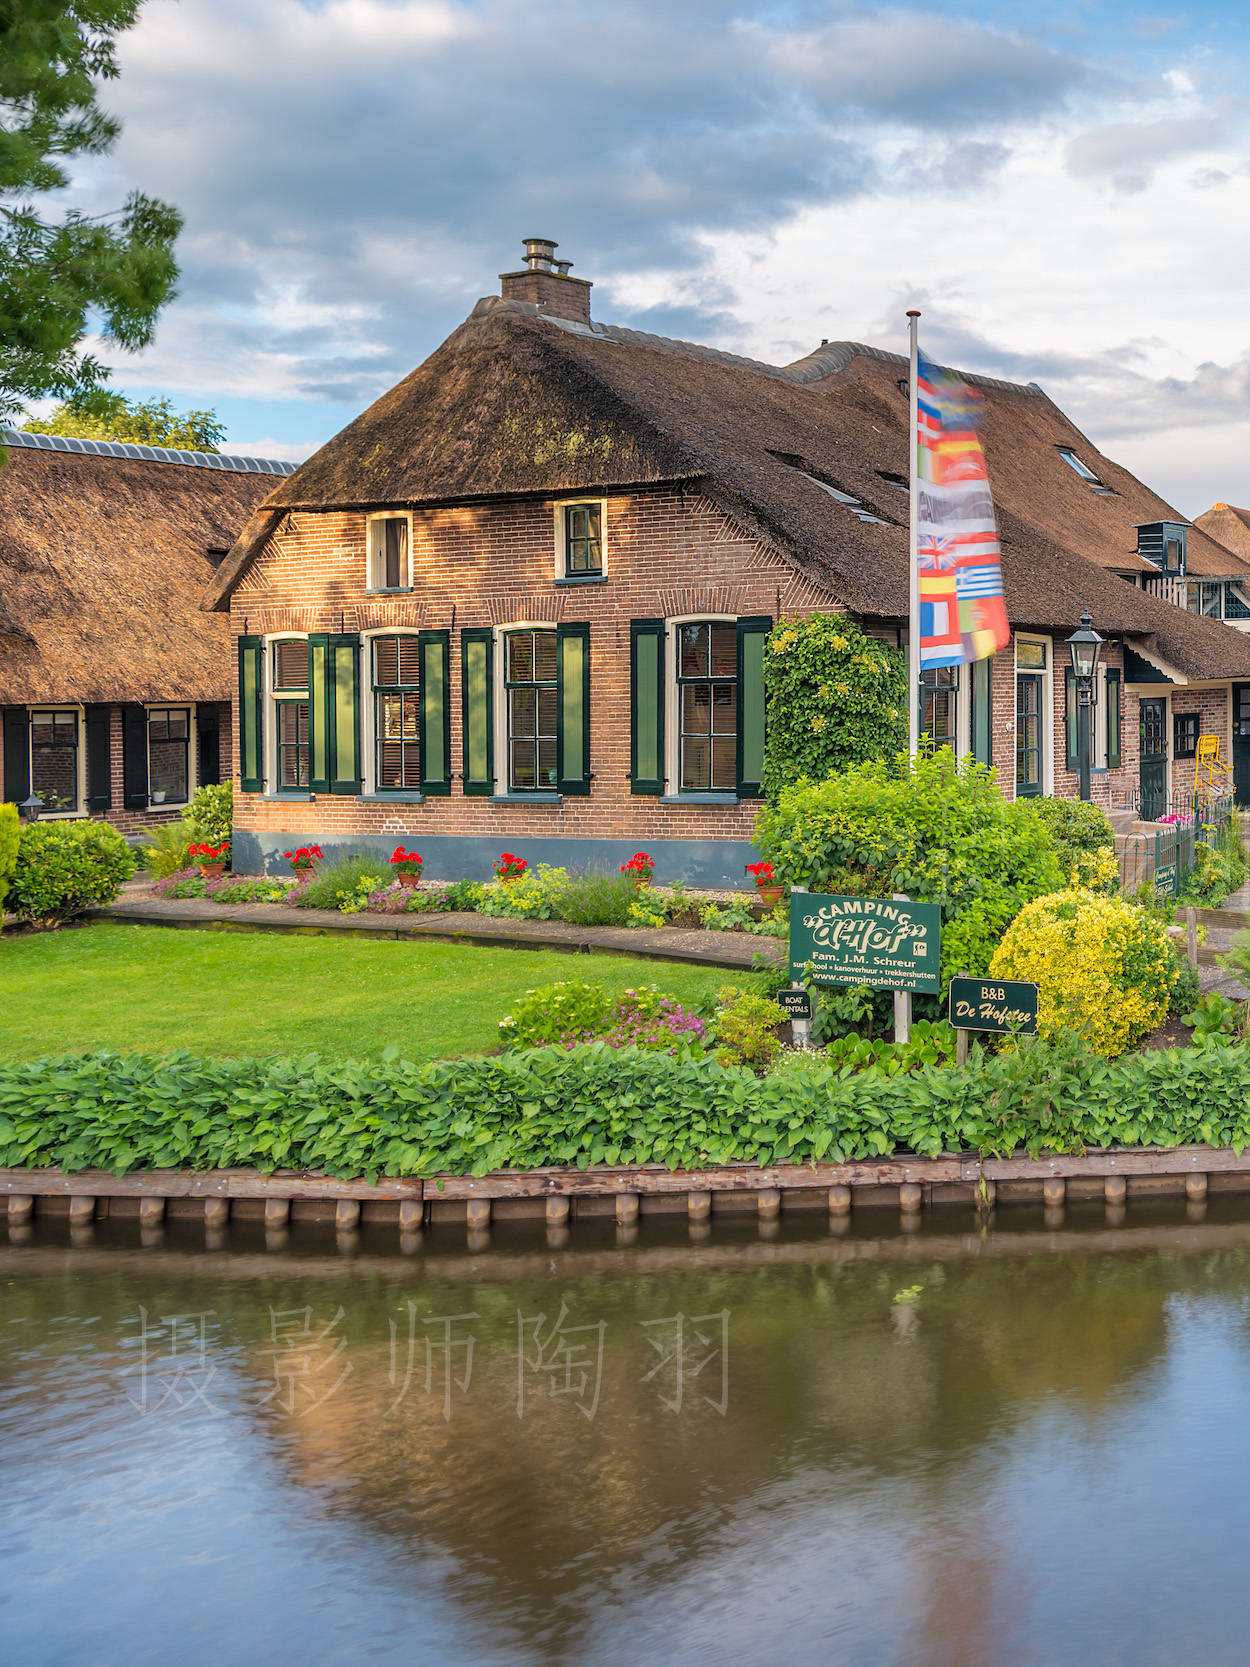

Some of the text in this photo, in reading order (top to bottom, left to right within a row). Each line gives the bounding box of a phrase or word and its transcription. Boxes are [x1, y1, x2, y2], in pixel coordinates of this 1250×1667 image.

[818, 901, 912, 925] CAMPING
[812, 951, 917, 968] Fam. J.M. Schreur
[812, 972, 917, 988] www.campingdehof.nl
[834, 964, 878, 975] kanoverhuur
[884, 969, 936, 980] trekkershutten
[785, 996, 803, 1004] BOAT
[981, 986, 1006, 1001] B&B
[955, 1000, 976, 1018] De
